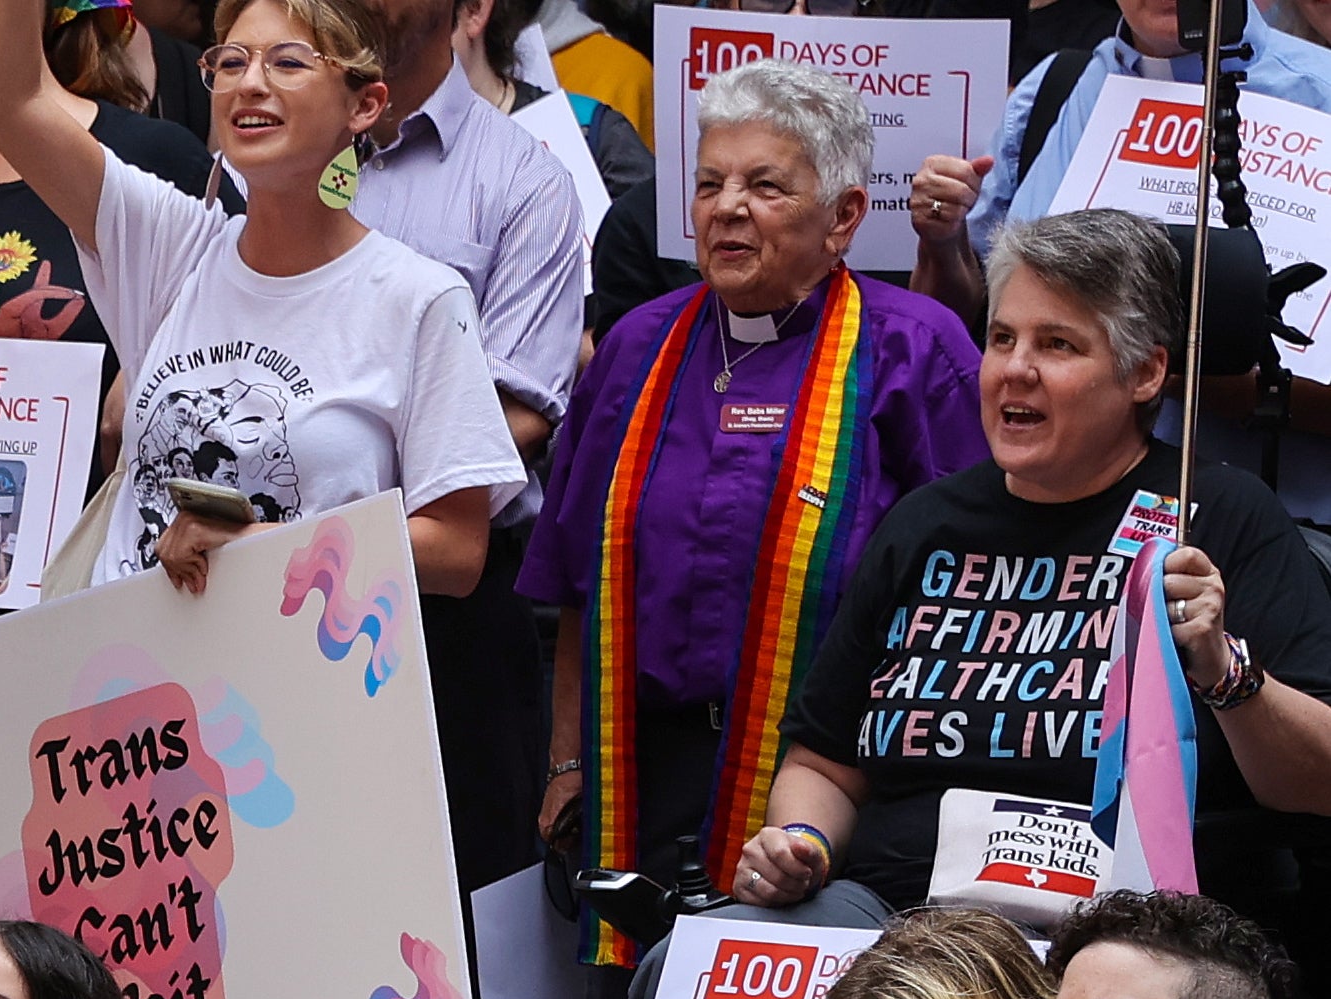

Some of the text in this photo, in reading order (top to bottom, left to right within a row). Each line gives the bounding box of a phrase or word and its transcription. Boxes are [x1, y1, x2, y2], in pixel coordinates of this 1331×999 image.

[780, 41, 889, 67] DAYS OF
[1129, 112, 1203, 158] 100
[1282, 132, 1323, 157] OF
[1140, 176, 1174, 192] WHAT
[1288, 203, 1317, 220] FOR
[136, 354, 186, 410] BELIEVE
[187, 348, 205, 370] IN
[209, 340, 255, 365] WHAT
[254, 346, 301, 383] COULD
[22, 440, 37, 453] UP
[1134, 520, 1172, 536] TRANS
[921, 550, 1125, 601] GENDER
[886, 605, 1119, 654] AFFIRMIN
[857, 710, 1103, 758] AVES LIVE
[35, 718, 189, 804] Trans
[38, 798, 219, 896] Justice
[988, 830, 1100, 859] mess with
[1018, 814, 1082, 839] Don't
[982, 847, 1100, 878] Trans kids.
[73, 875, 205, 965] Can't
[714, 953, 803, 999] 100
